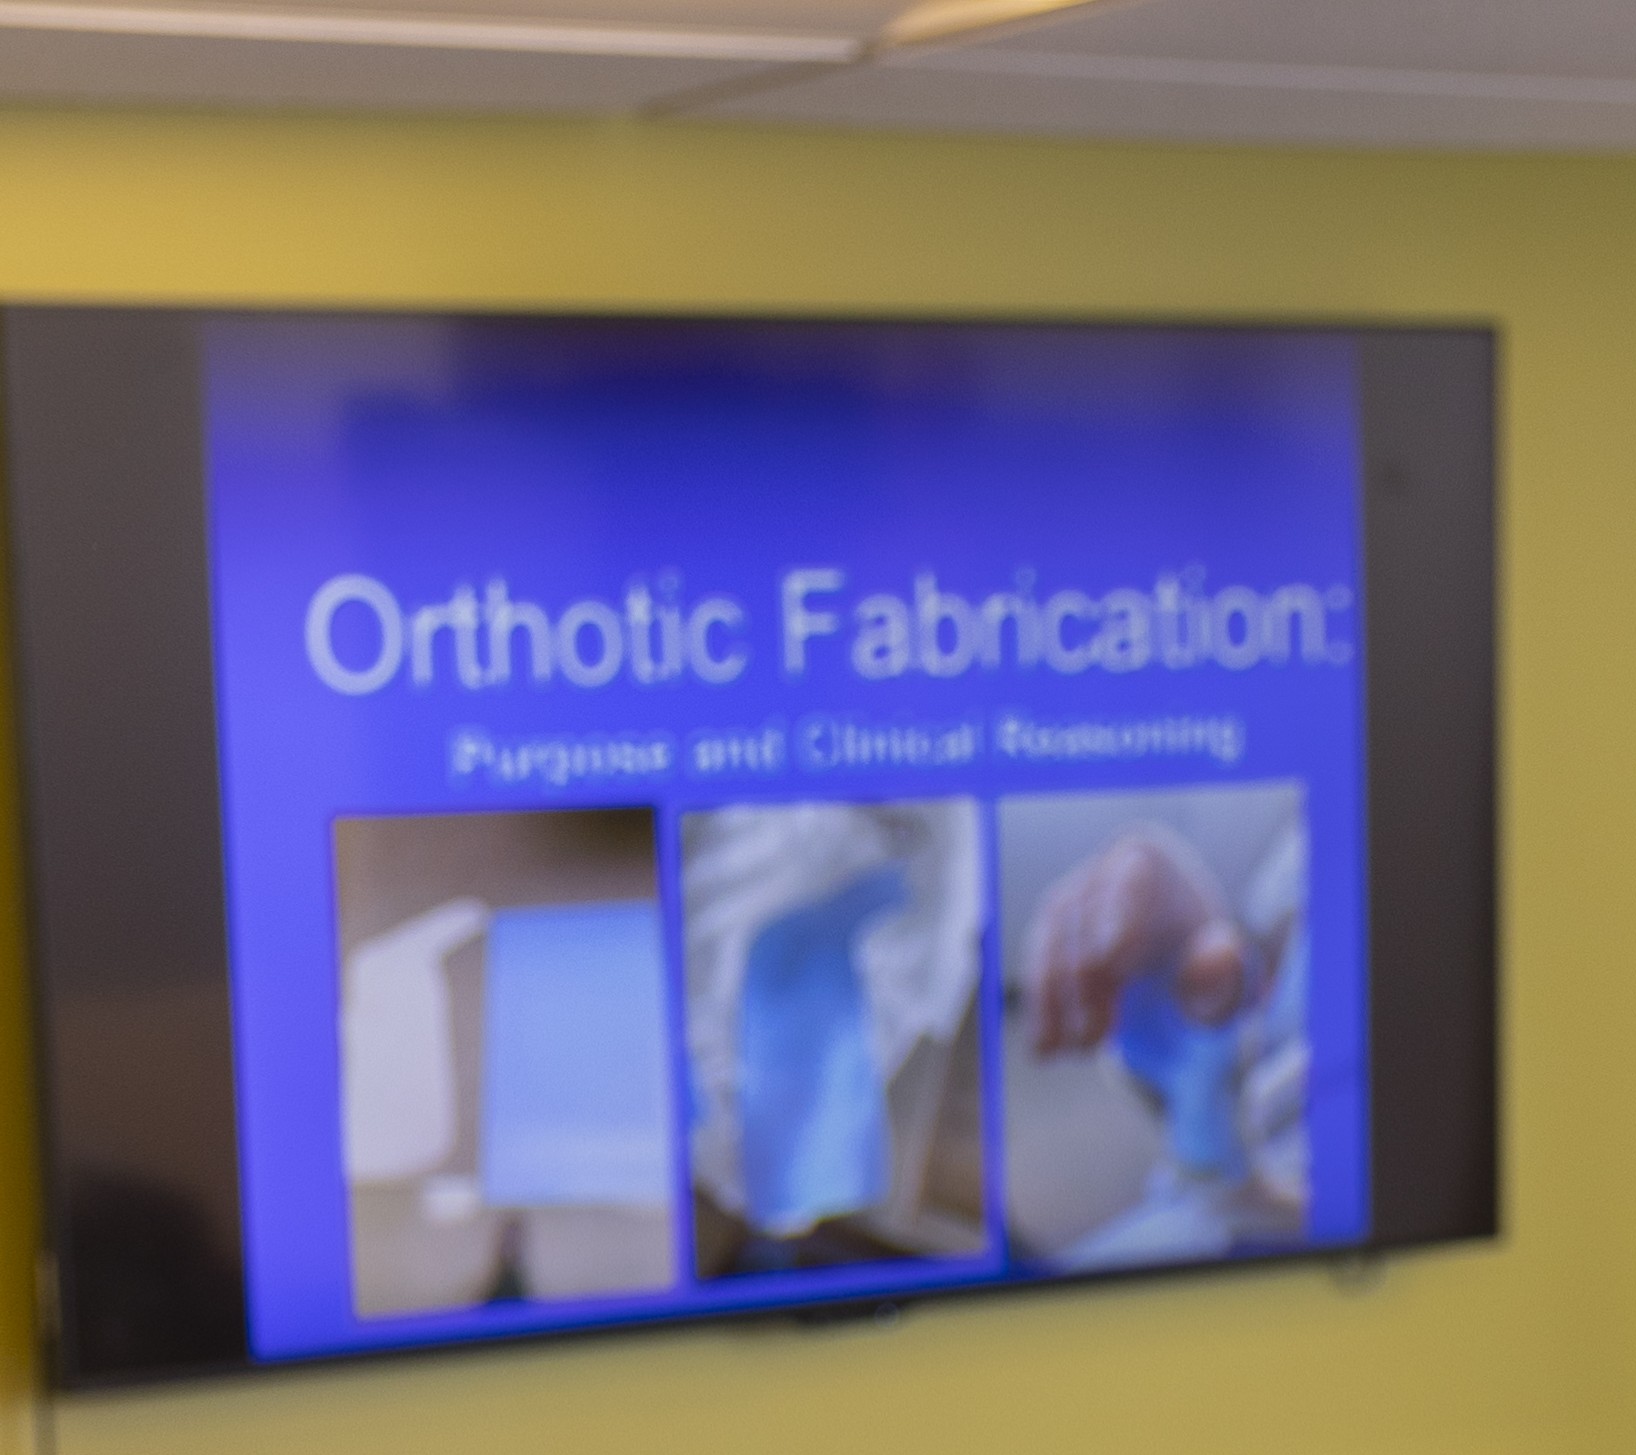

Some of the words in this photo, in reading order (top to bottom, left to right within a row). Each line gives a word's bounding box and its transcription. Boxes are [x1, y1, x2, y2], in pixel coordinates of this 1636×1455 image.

[304, 568, 749, 694] Orthotic
[451, 730, 670, 787] Purpose
[694, 726, 787, 773] and
[804, 718, 977, 767] Clinical
[998, 712, 1242, 763] Reasoning
